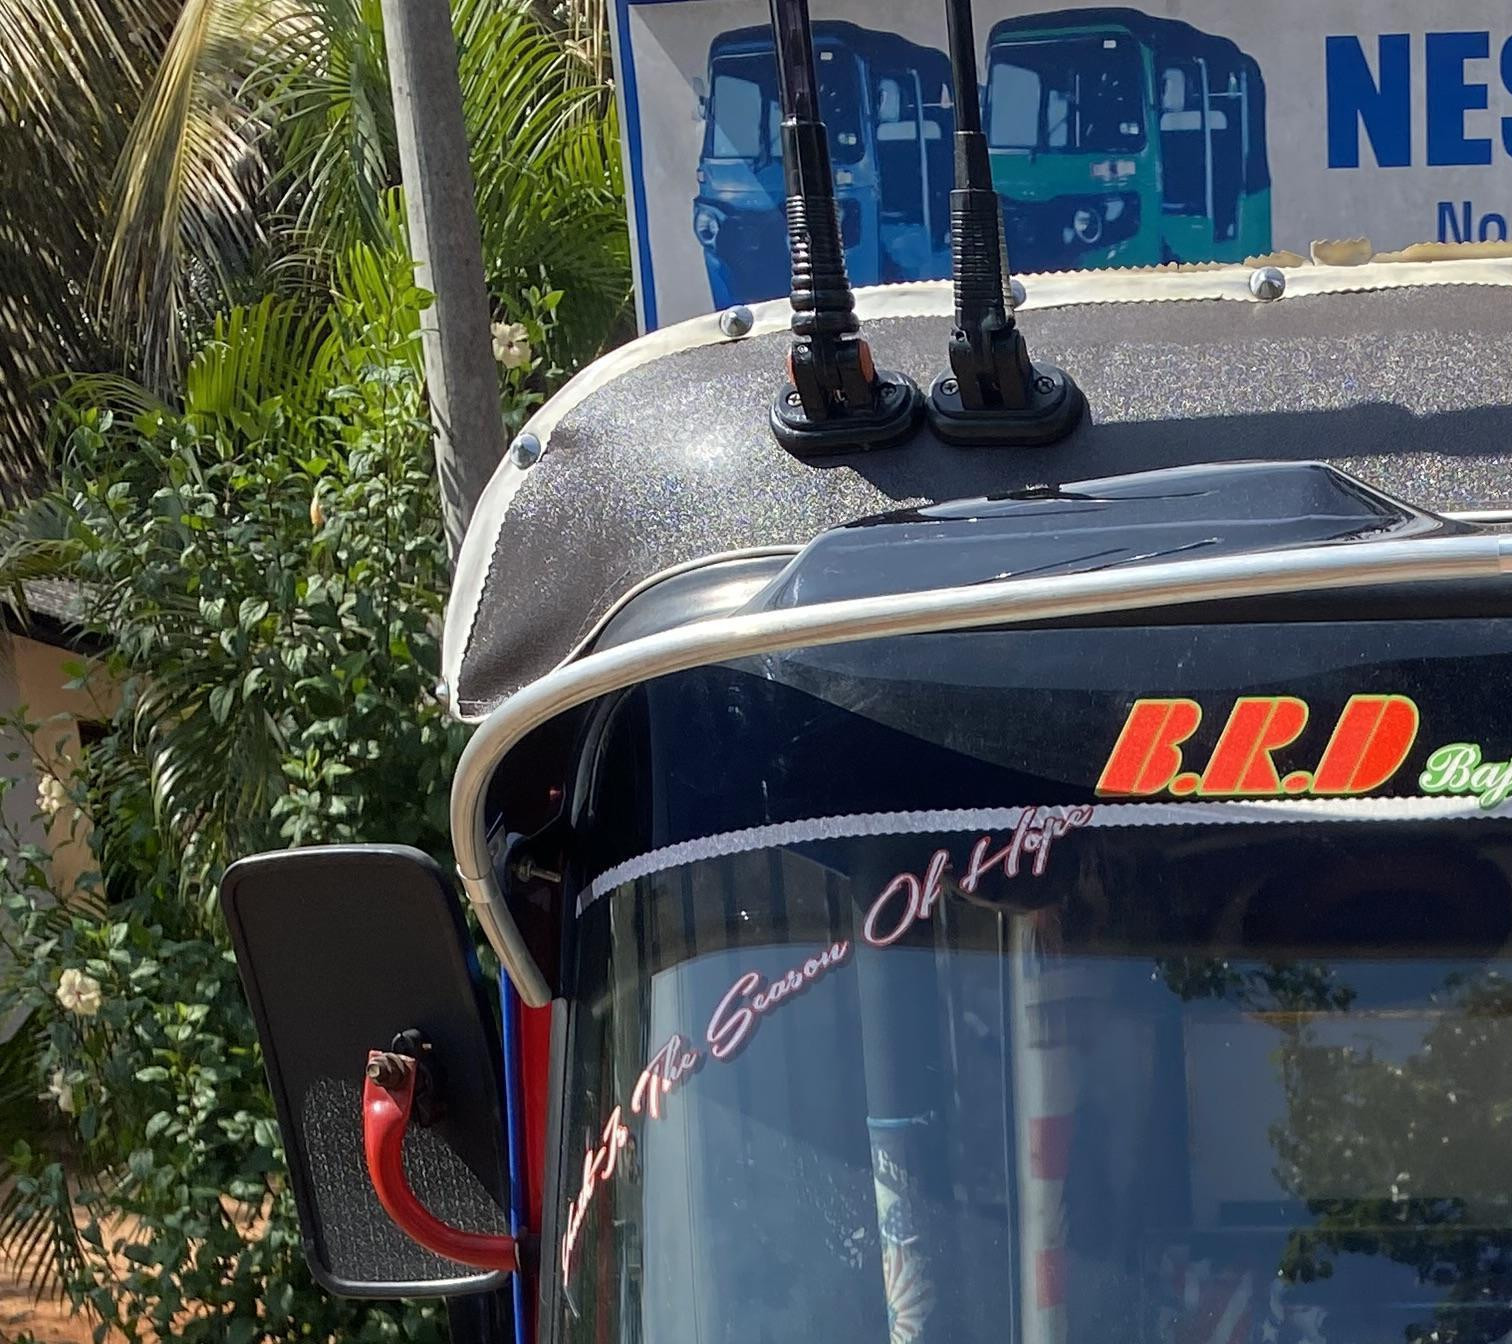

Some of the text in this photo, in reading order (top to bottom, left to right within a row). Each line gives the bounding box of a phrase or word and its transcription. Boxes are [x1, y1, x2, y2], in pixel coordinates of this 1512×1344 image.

[1094, 694, 1419, 797] B.R.D
[631, 1034, 697, 1119] The
[706, 940, 849, 1059] Season
[863, 849, 950, 948] Of
[959, 806, 1093, 893] Hope
